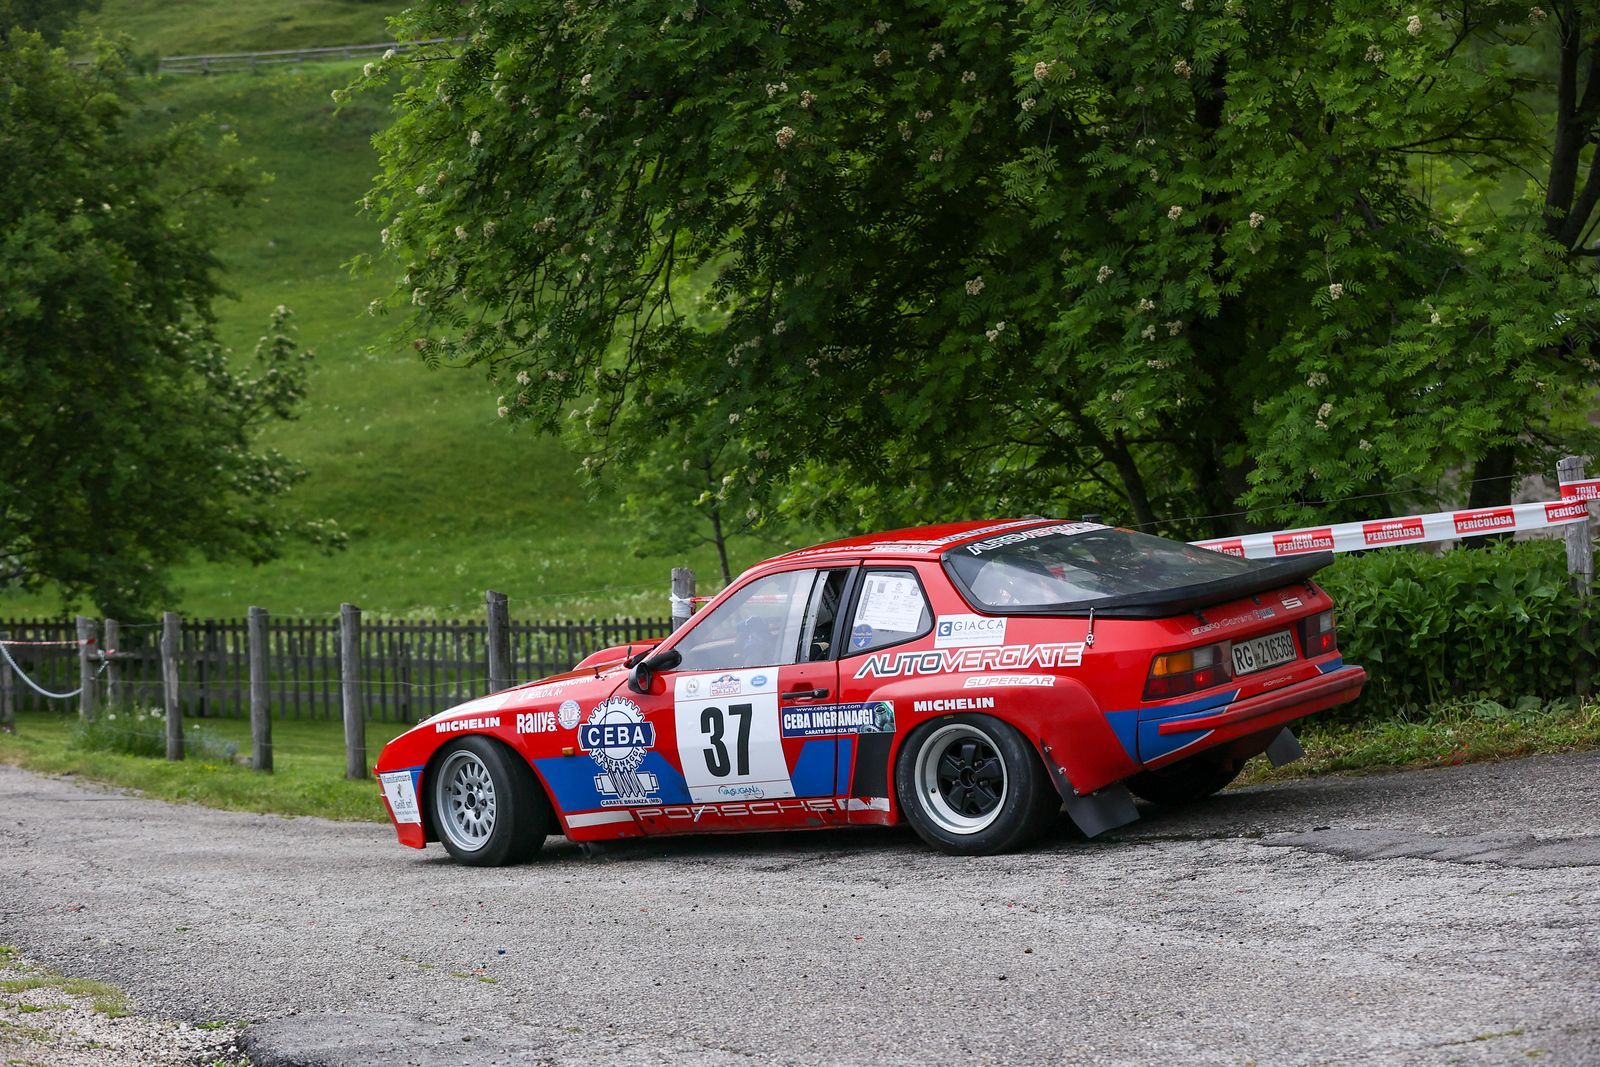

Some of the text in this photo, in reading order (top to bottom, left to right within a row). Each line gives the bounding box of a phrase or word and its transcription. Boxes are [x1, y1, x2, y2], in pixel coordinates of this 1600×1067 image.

[1456, 515, 1514, 530] PERICOLOSA
[1366, 527, 1423, 542] PERICOLOSA
[1276, 537, 1332, 553] PERICOLOSA
[953, 619, 1004, 632] GIACCA
[853, 642, 1085, 680] AUTOVERGIATE
[1233, 633, 1295, 671] RG 216369
[965, 676, 1054, 688] SUPERCAR
[1263, 675, 1293, 687] PORSCHE
[914, 697, 994, 712] MICHELIN
[436, 717, 500, 733] MICHELIN
[516, 711, 549, 734] Rally
[783, 709, 874, 730] CEBA INGRANAGGI
[587, 725, 646, 747] CEBA
[700, 703, 753, 777] 37
[593, 747, 641, 768] INGRANAGGI
[635, 799, 835, 822] PORSCHE
